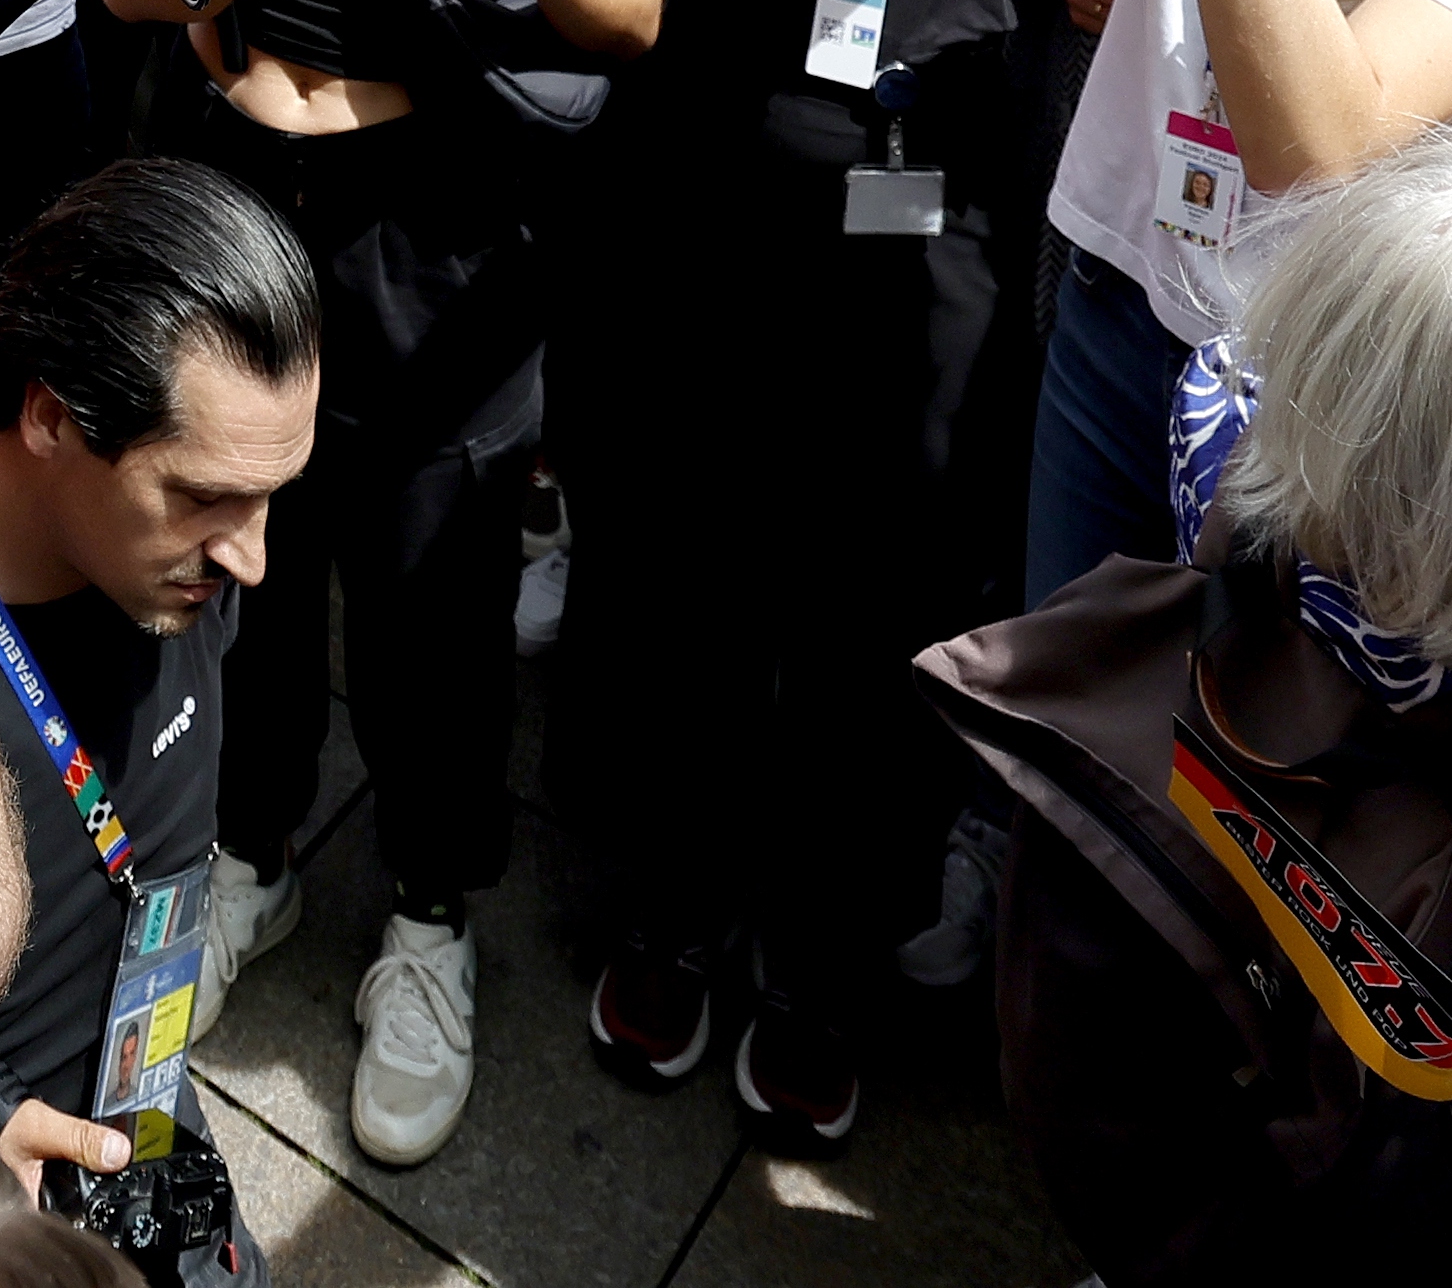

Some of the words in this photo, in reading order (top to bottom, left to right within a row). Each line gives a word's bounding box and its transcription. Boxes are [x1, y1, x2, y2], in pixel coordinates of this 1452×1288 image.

[1287, 894, 1333, 952] ROCK
[1334, 954, 1370, 1004] UND
[1371, 1007, 1409, 1051] POP
